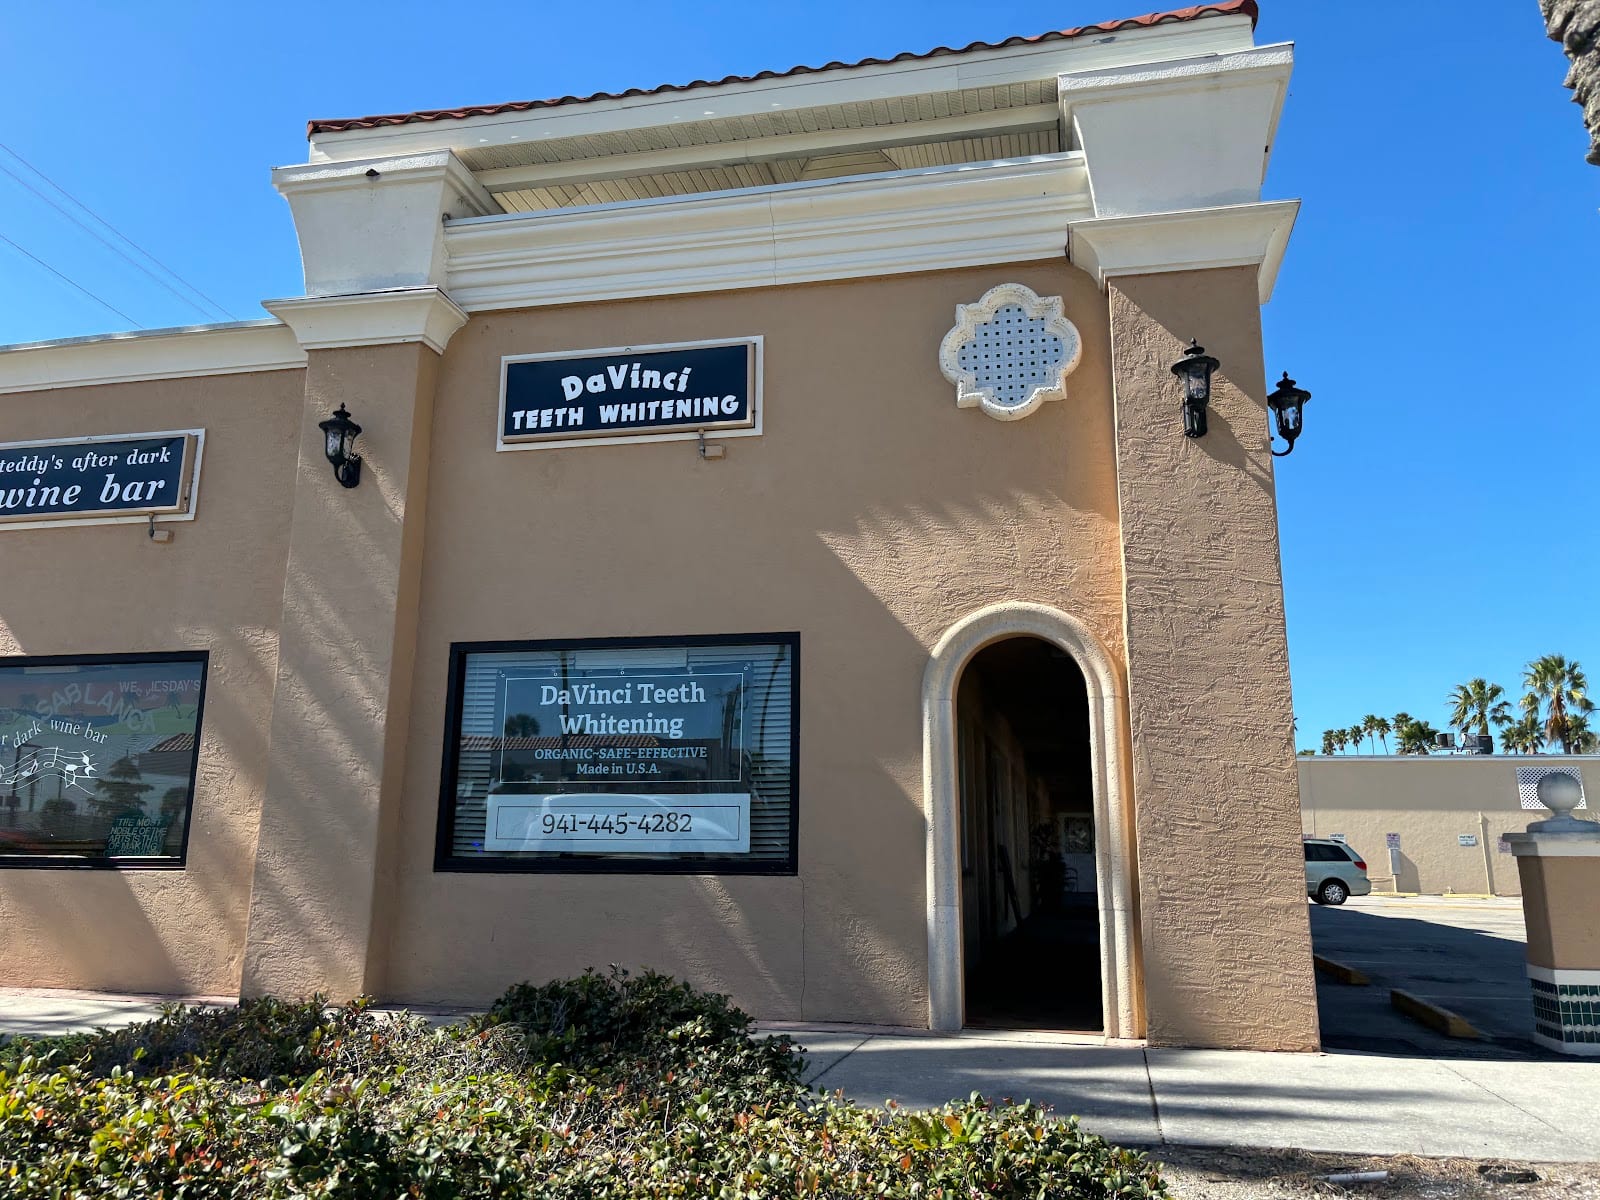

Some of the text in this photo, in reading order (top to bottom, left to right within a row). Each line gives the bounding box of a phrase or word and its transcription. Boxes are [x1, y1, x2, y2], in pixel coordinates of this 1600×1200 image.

[561, 363, 692, 401] DaVinci
[512, 394, 739, 430] TEETH WHITENING
[0, 447, 171, 475] teddy's after dark
[0, 473, 166, 509] wine bar
[119, 679, 200, 694] WEESDAY'S
[540, 681, 706, 705] DaVinci Teeth
[13, 720, 42, 748] dark
[50, 719, 81, 735] wine
[84, 722, 108, 744] bar
[558, 712, 685, 739] Whitening
[576, 762, 662, 775] Made in U.S.A.
[542, 812, 692, 835] 941-445-4282
